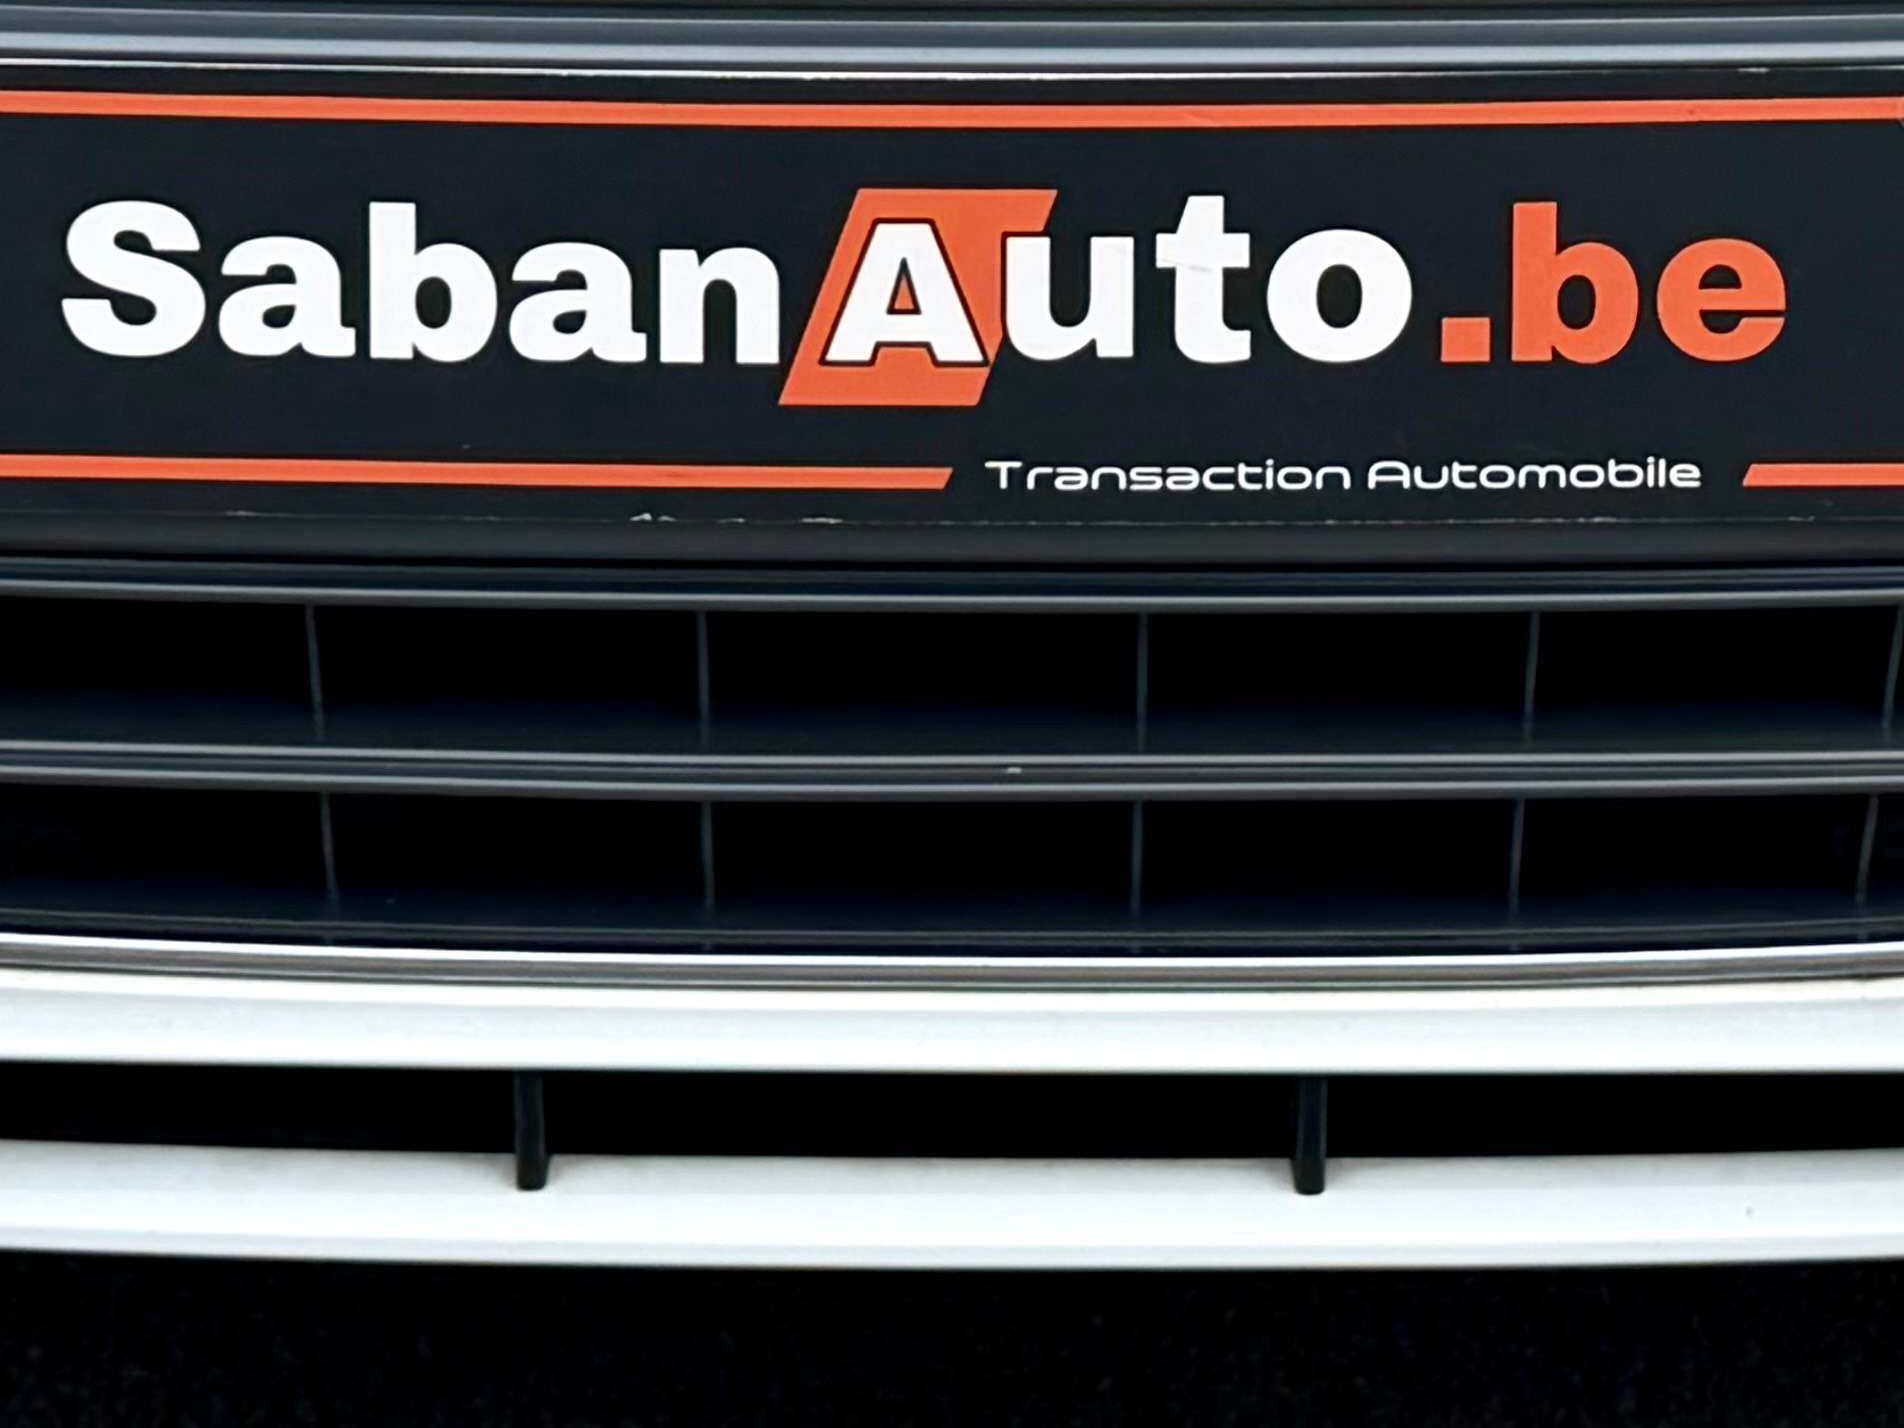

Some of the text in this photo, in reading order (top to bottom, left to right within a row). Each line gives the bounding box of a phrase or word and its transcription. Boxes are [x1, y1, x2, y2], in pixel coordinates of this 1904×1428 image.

[61, 188, 1786, 406] SabanAuto.be
[984, 456, 1702, 492] Transaction Automobile
